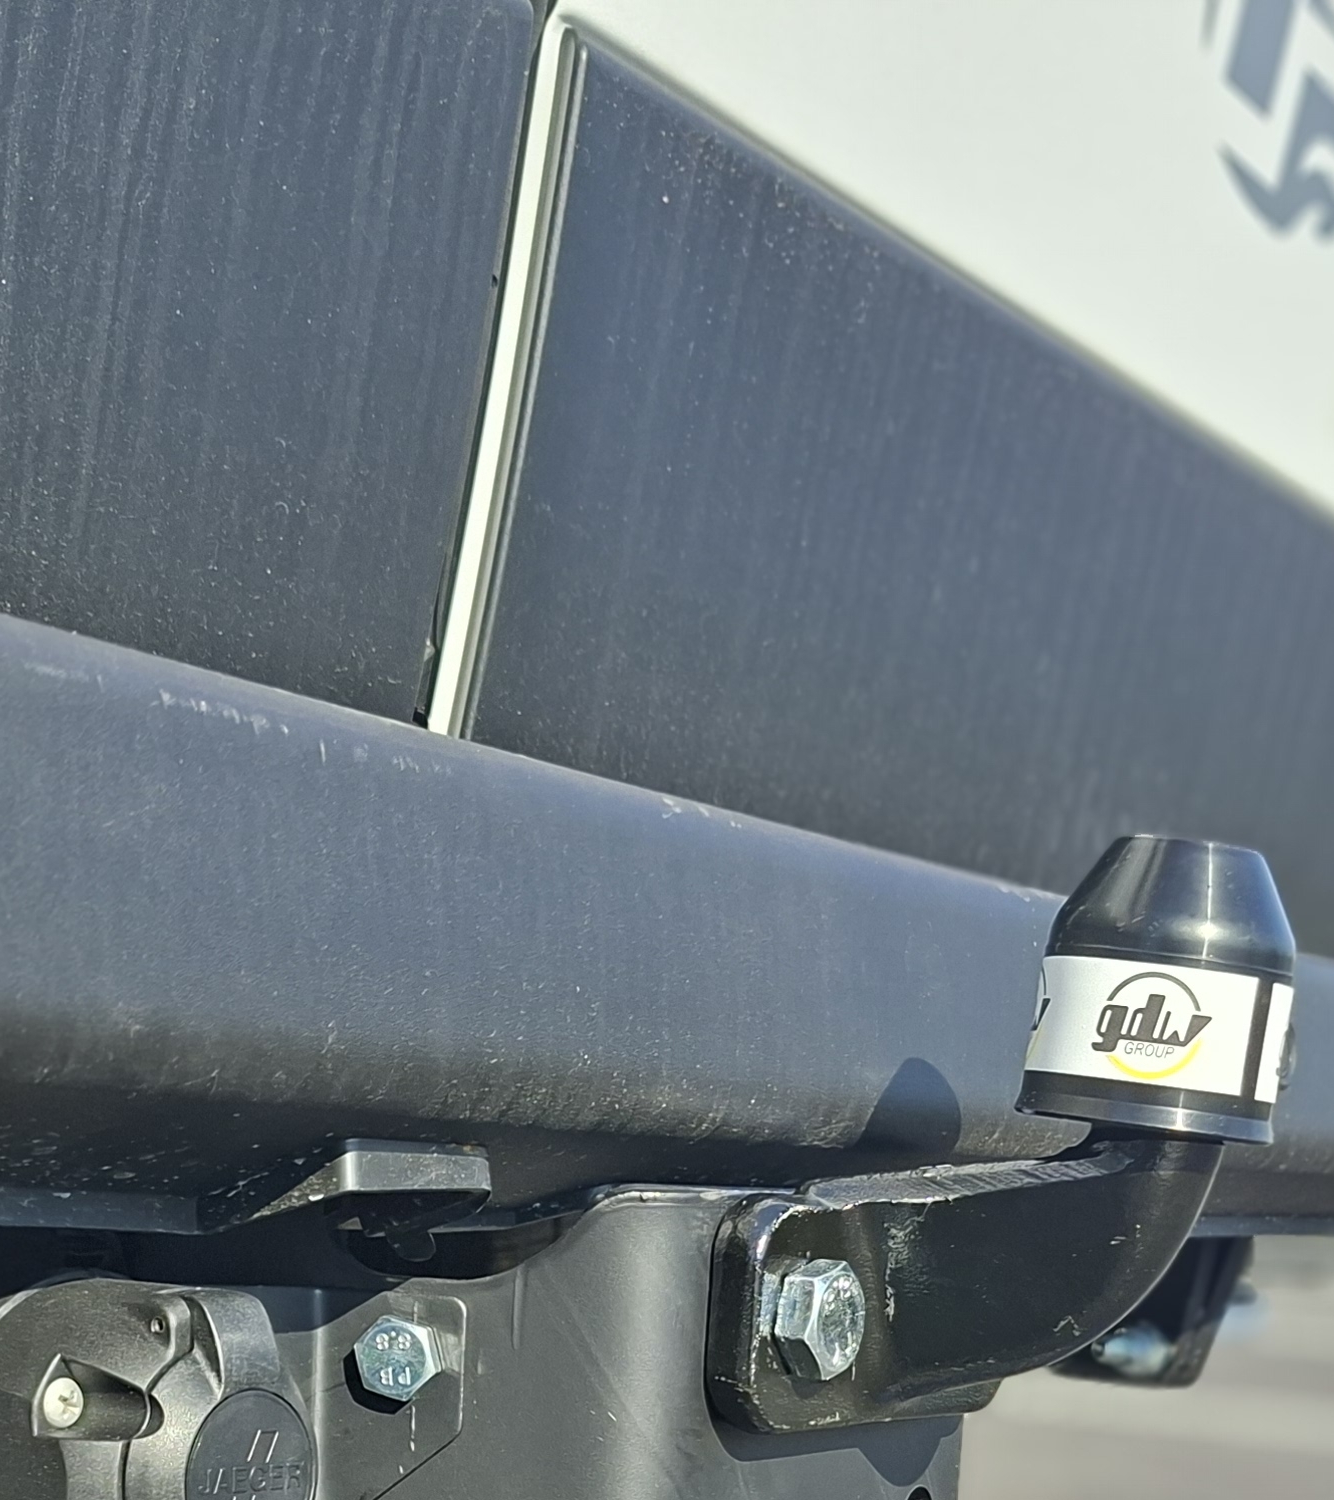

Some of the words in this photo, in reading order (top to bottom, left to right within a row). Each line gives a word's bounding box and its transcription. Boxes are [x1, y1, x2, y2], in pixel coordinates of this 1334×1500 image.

[1123, 1041, 1175, 1059] GROUP
[376, 1331, 412, 1352] 8.8
[198, 1461, 300, 1496] JAEGER
